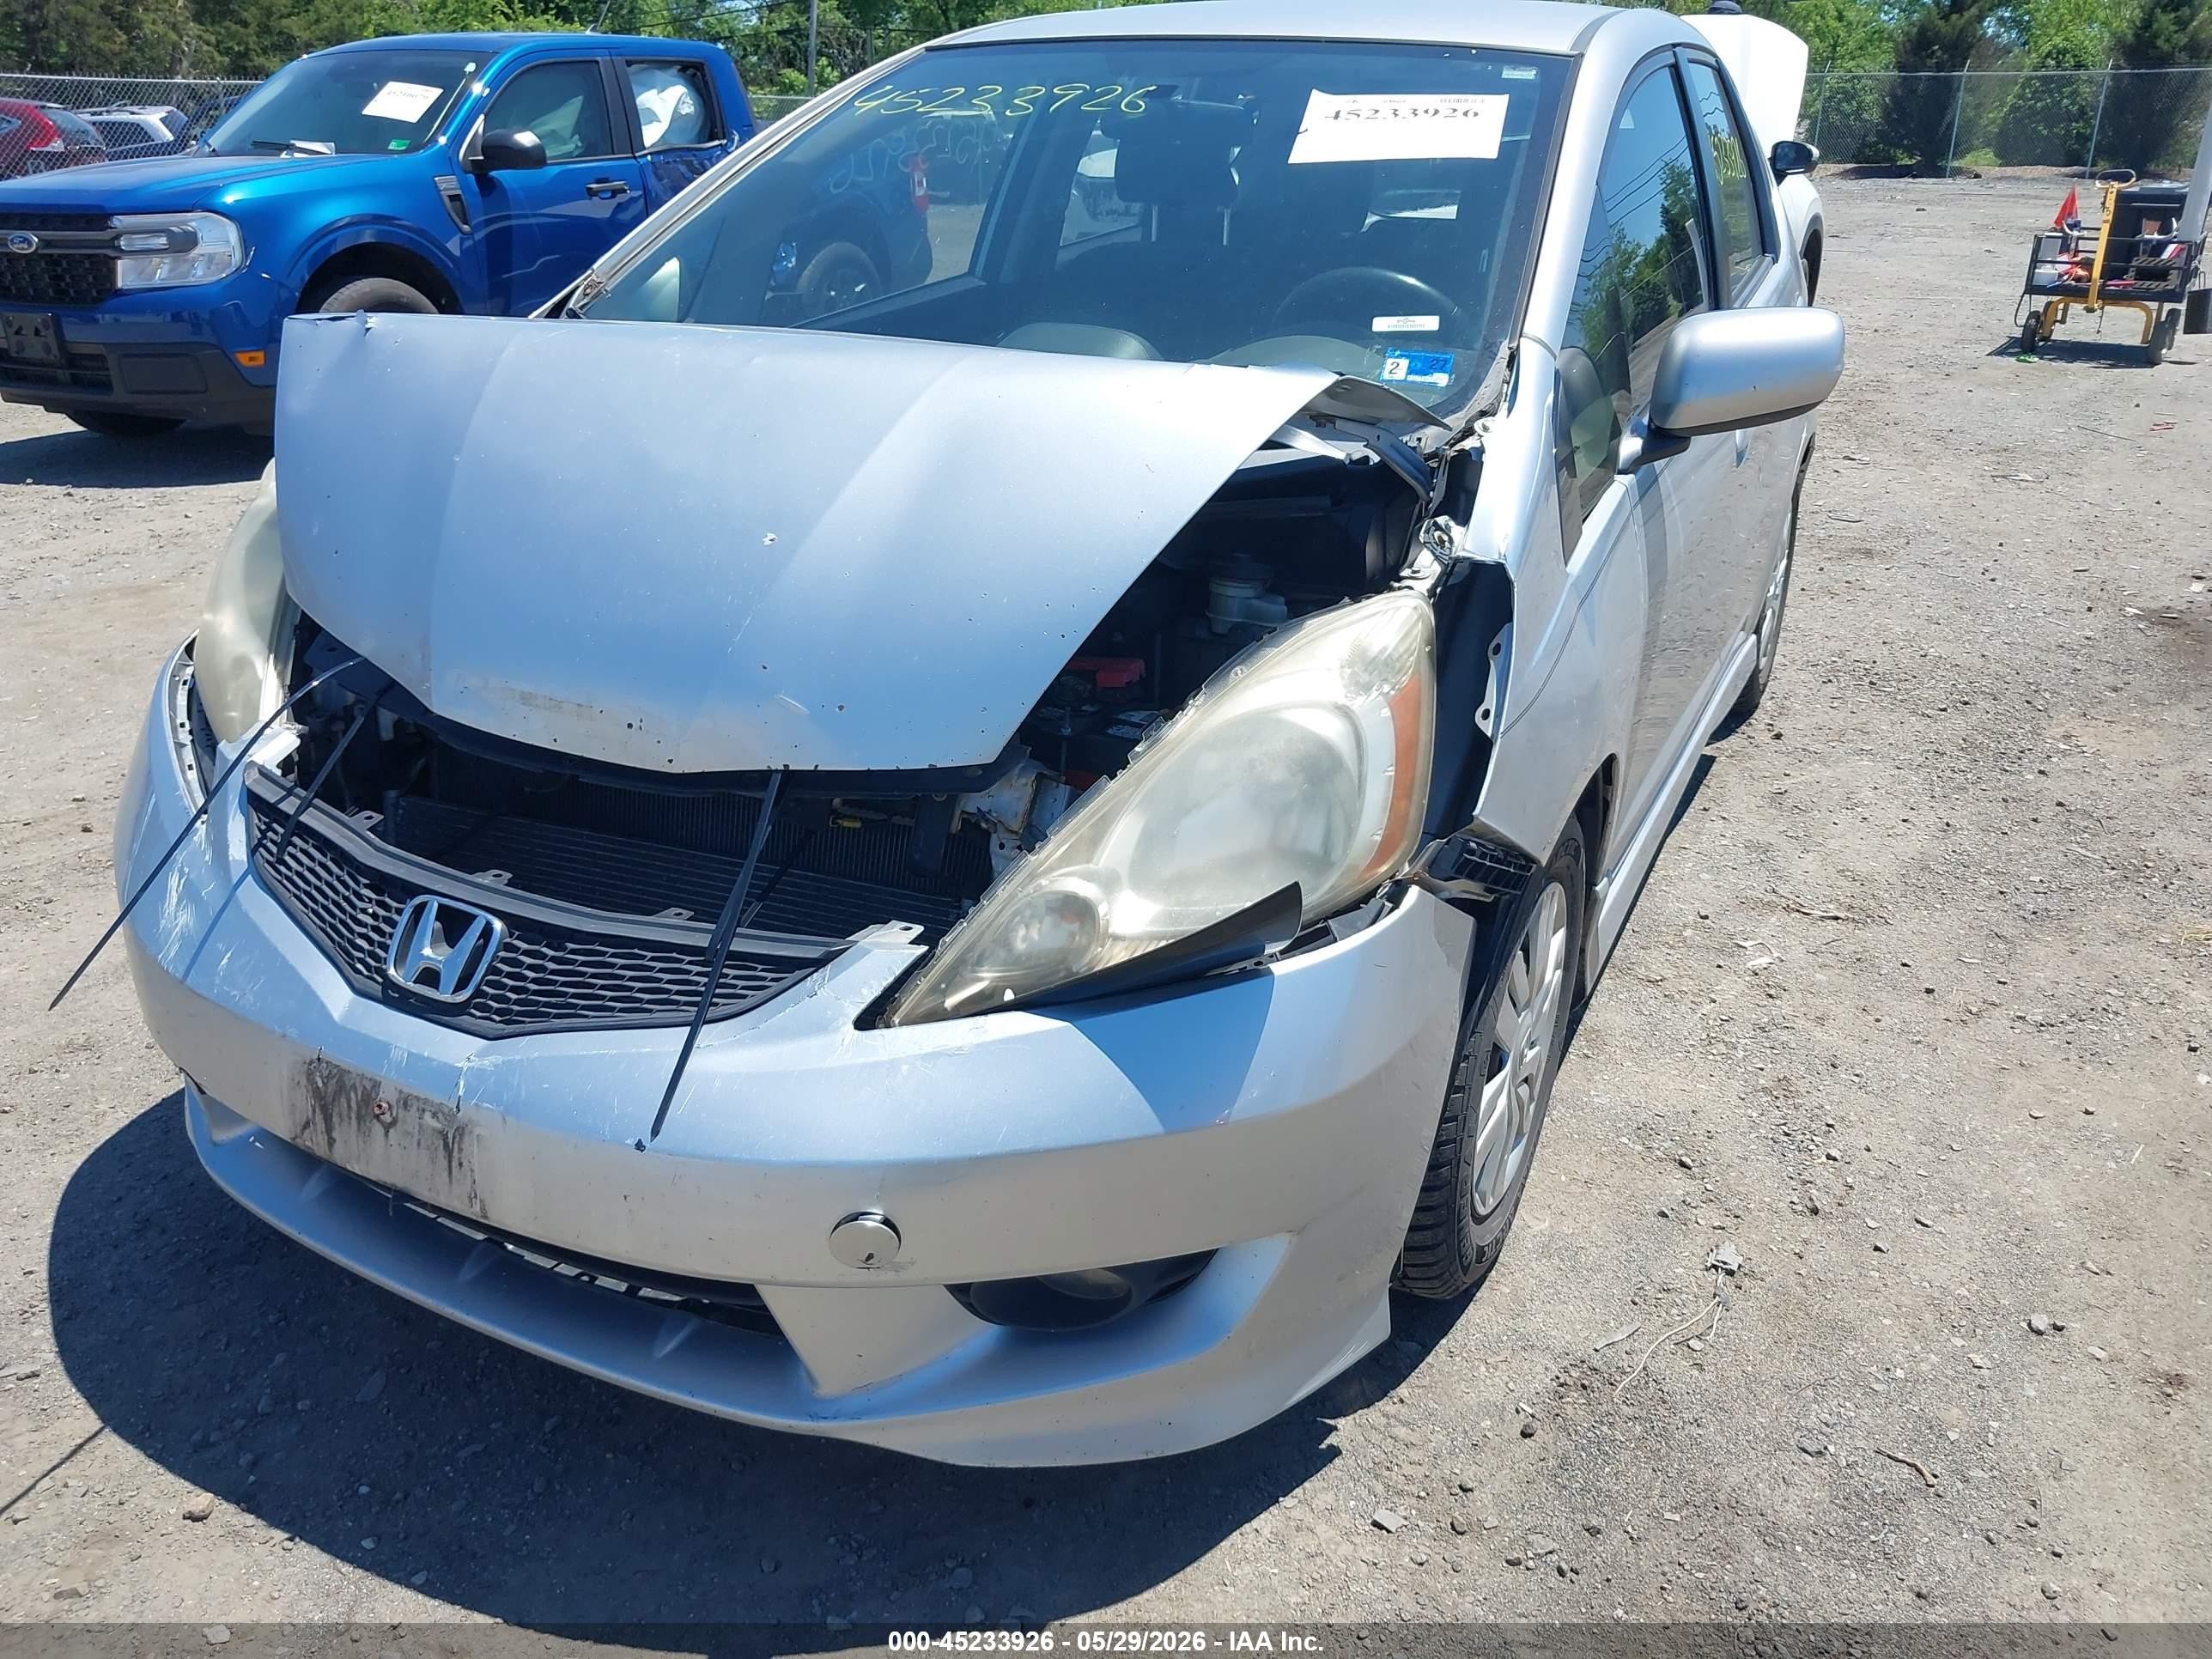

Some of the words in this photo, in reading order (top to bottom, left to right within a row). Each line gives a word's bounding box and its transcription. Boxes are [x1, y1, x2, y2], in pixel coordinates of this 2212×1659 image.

[854, 83, 1158, 117] 45233926
[1325, 107, 1479, 120] 45233926
[1388, 361, 1400, 375] 2
